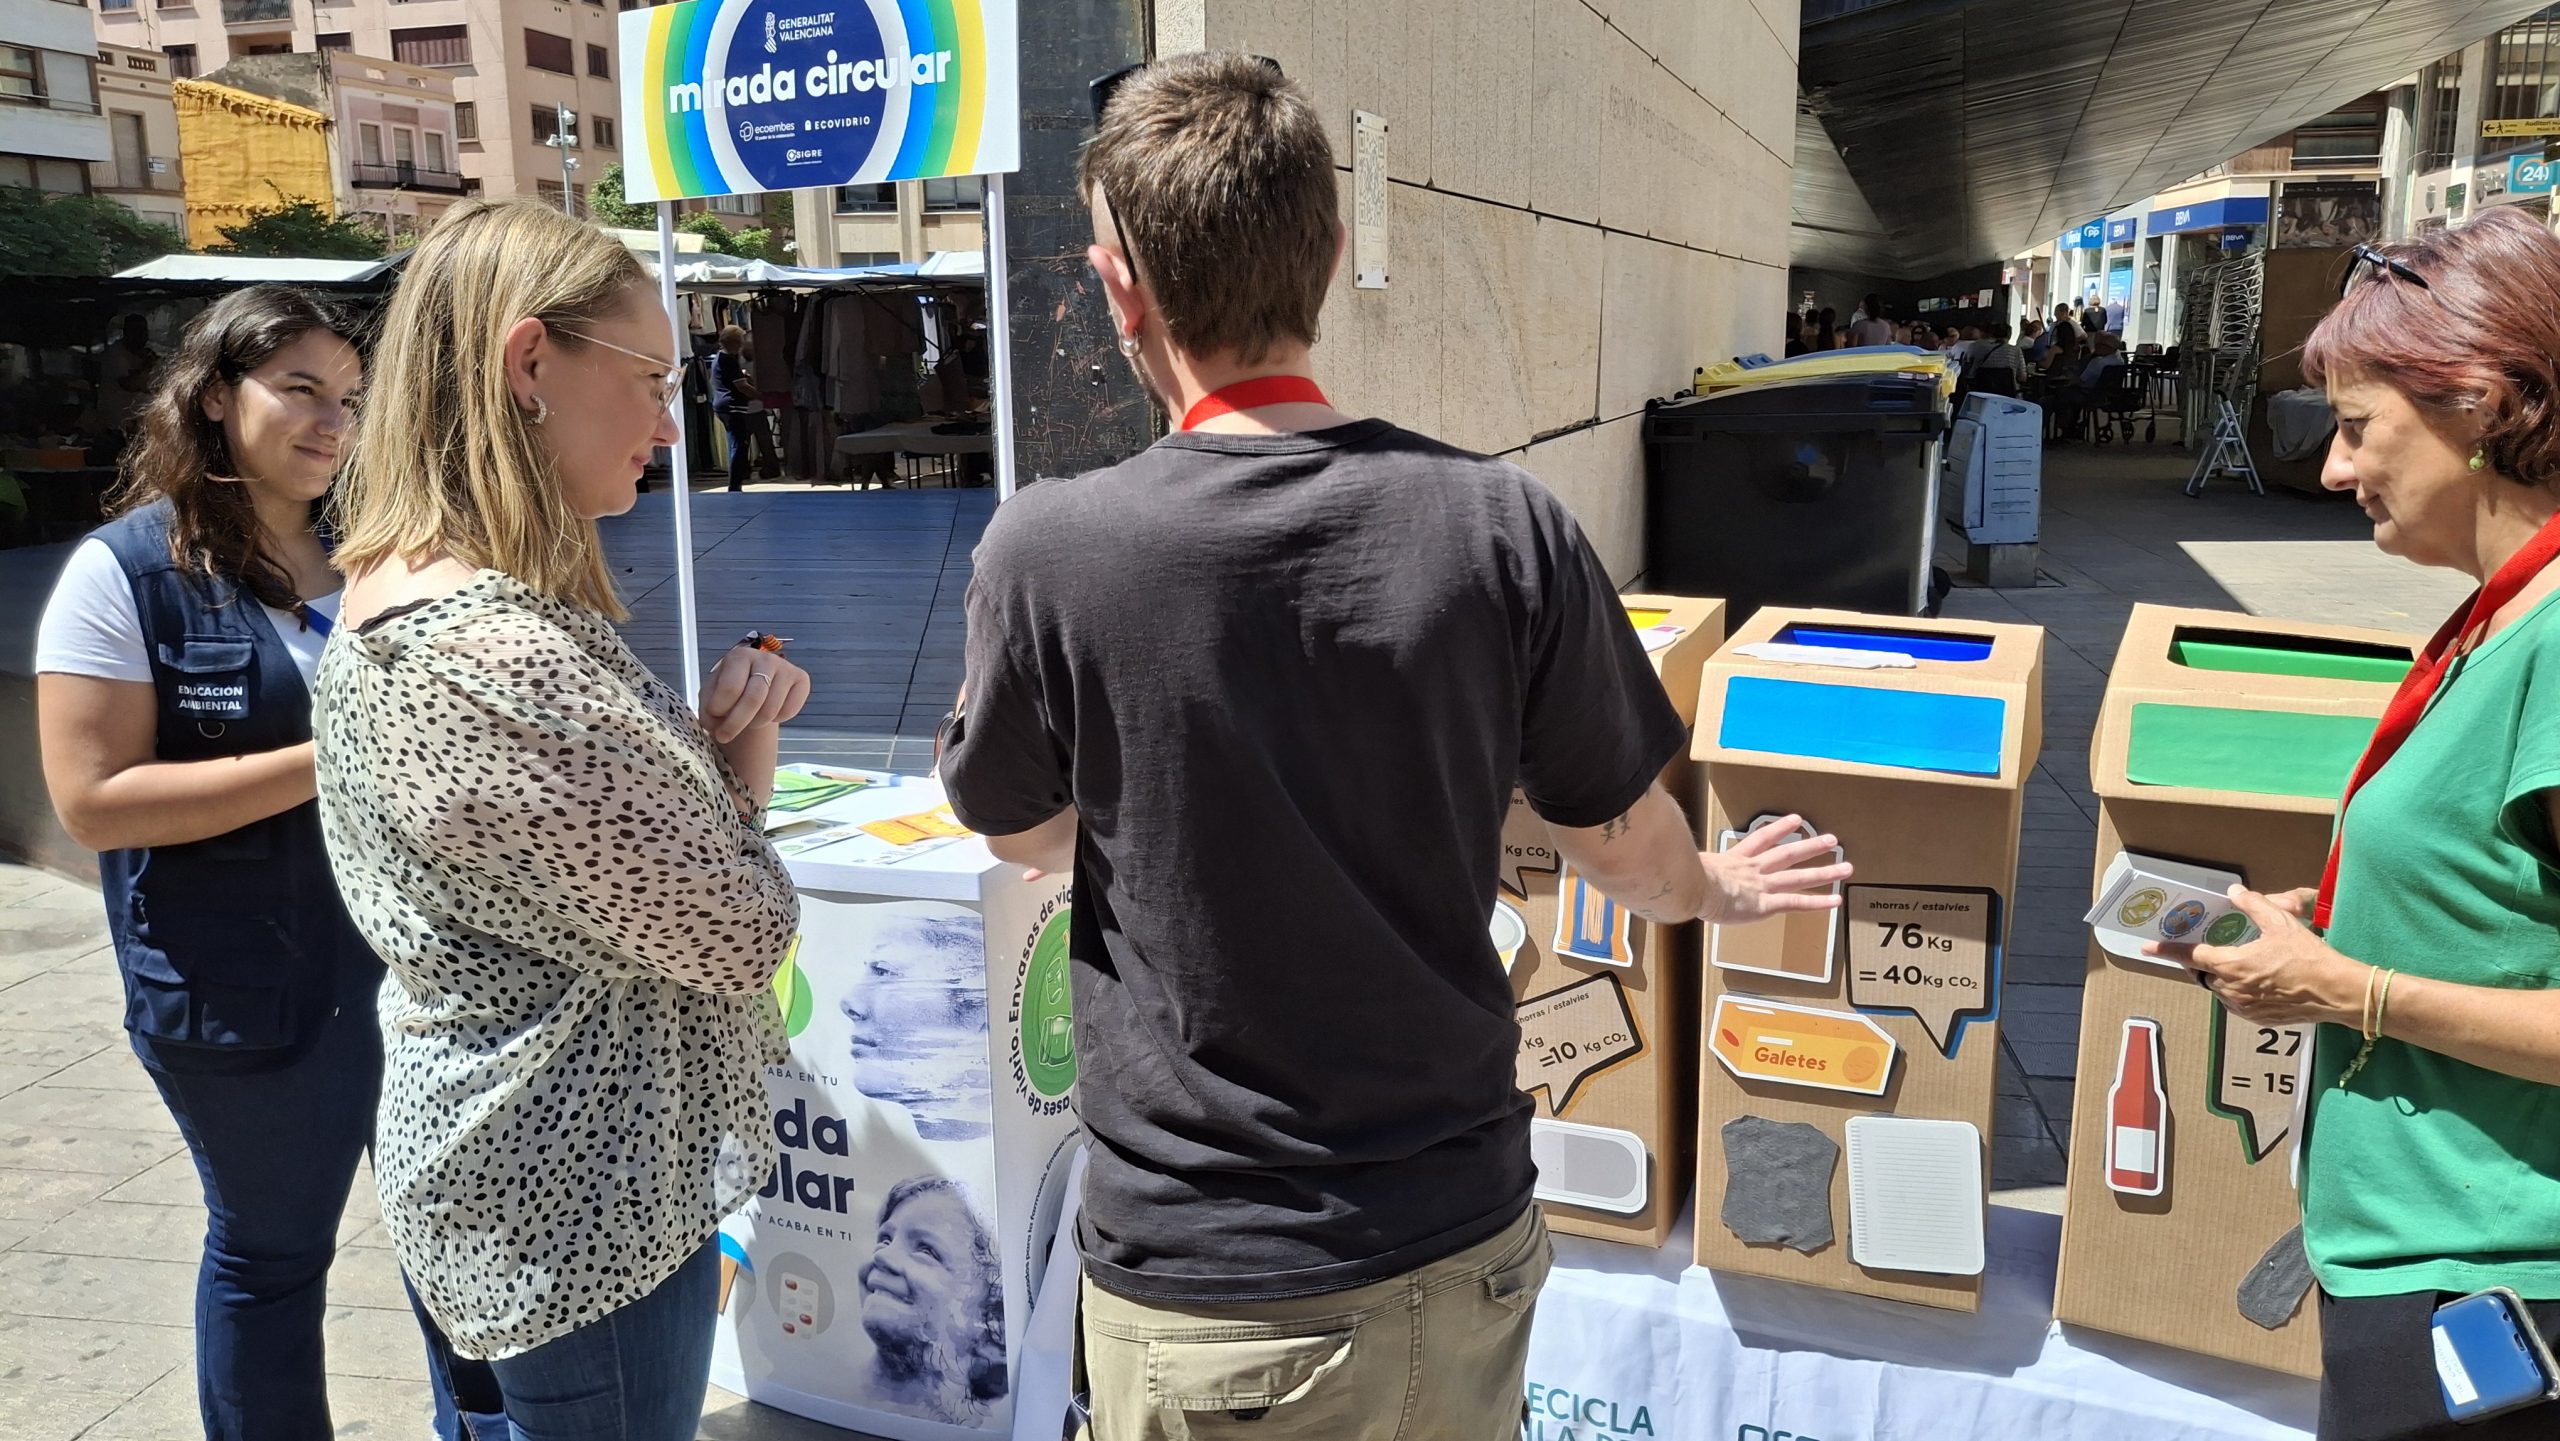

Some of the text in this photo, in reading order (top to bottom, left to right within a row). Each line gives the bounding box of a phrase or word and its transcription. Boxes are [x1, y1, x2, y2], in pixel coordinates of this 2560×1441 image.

[778, 12, 835, 30] GENERALITAT
[779, 25, 834, 42] VALENCIANA
[669, 45, 951, 113] mirada circular
[754, 122, 795, 134] ecoembes
[814, 116, 870, 130] ECOVIDRIO
[2175, 209, 2191, 226] BBVA
[2113, 224, 2126, 237] BBVA
[2225, 233, 2245, 241] BBVA
[179, 699, 242, 711] AMBIENTAL
[1505, 844, 1522, 857] Kg
[1055, 884, 1073, 906] vid
[1040, 899, 1054, 923] de
[1869, 901, 1970, 912] ahorras / estalvies
[1878, 922, 1953, 952] 76 Kg
[1009, 922, 1040, 1023] Envasos
[1553, 992, 1590, 1011] estalvies
[1525, 1036, 1545, 1050] Kg
[1583, 1041, 1601, 1053] Kg
[2256, 1028, 2302, 1057] 27
[1754, 1046, 1827, 1071] Galetes
[800, 1071, 815, 1083] EN
[822, 1075, 838, 1086] TU
[2232, 1075, 2251, 1088] =
[1028, 1092, 1041, 1116] de
[1043, 1095, 1070, 1116] ases
[774, 1098, 849, 1157] da
[756, 1213, 762, 1221] Y
[769, 1216, 811, 1233] ACABA
[817, 1226, 833, 1238] EN
[840, 1231, 852, 1241] TI
[1528, 1382, 1655, 1437] ECICLA
